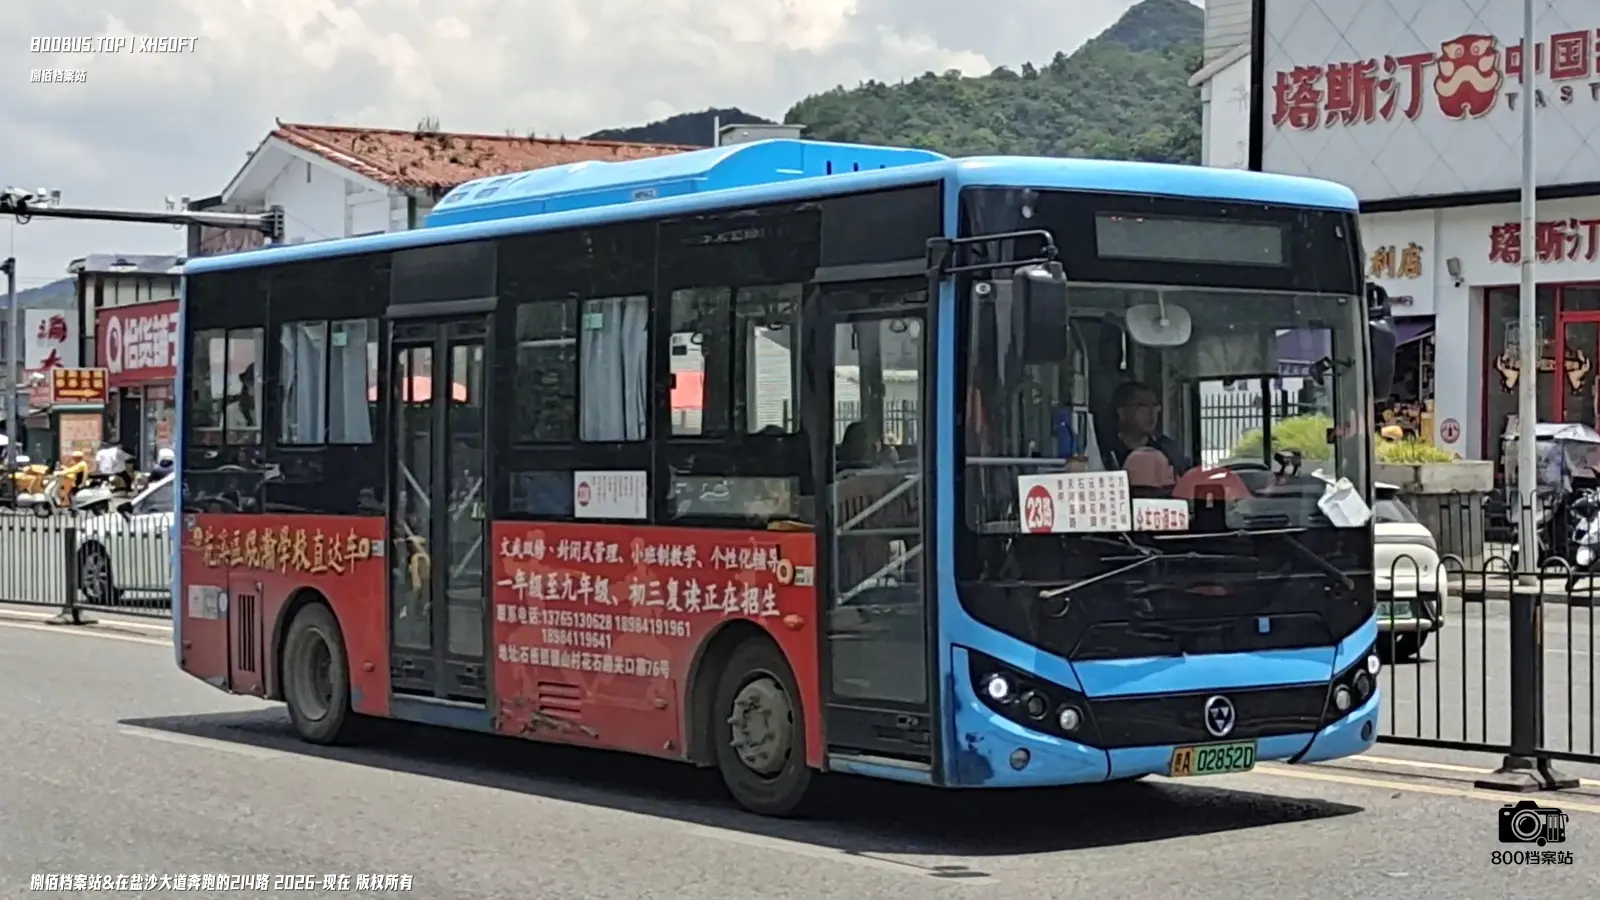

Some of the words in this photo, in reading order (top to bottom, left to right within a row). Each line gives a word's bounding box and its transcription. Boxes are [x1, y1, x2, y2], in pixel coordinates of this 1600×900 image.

[1272, 52, 1437, 131] 塔斯汀
[1505, 28, 1600, 85] 中国
[1489, 218, 1600, 265] 塔斯汀
